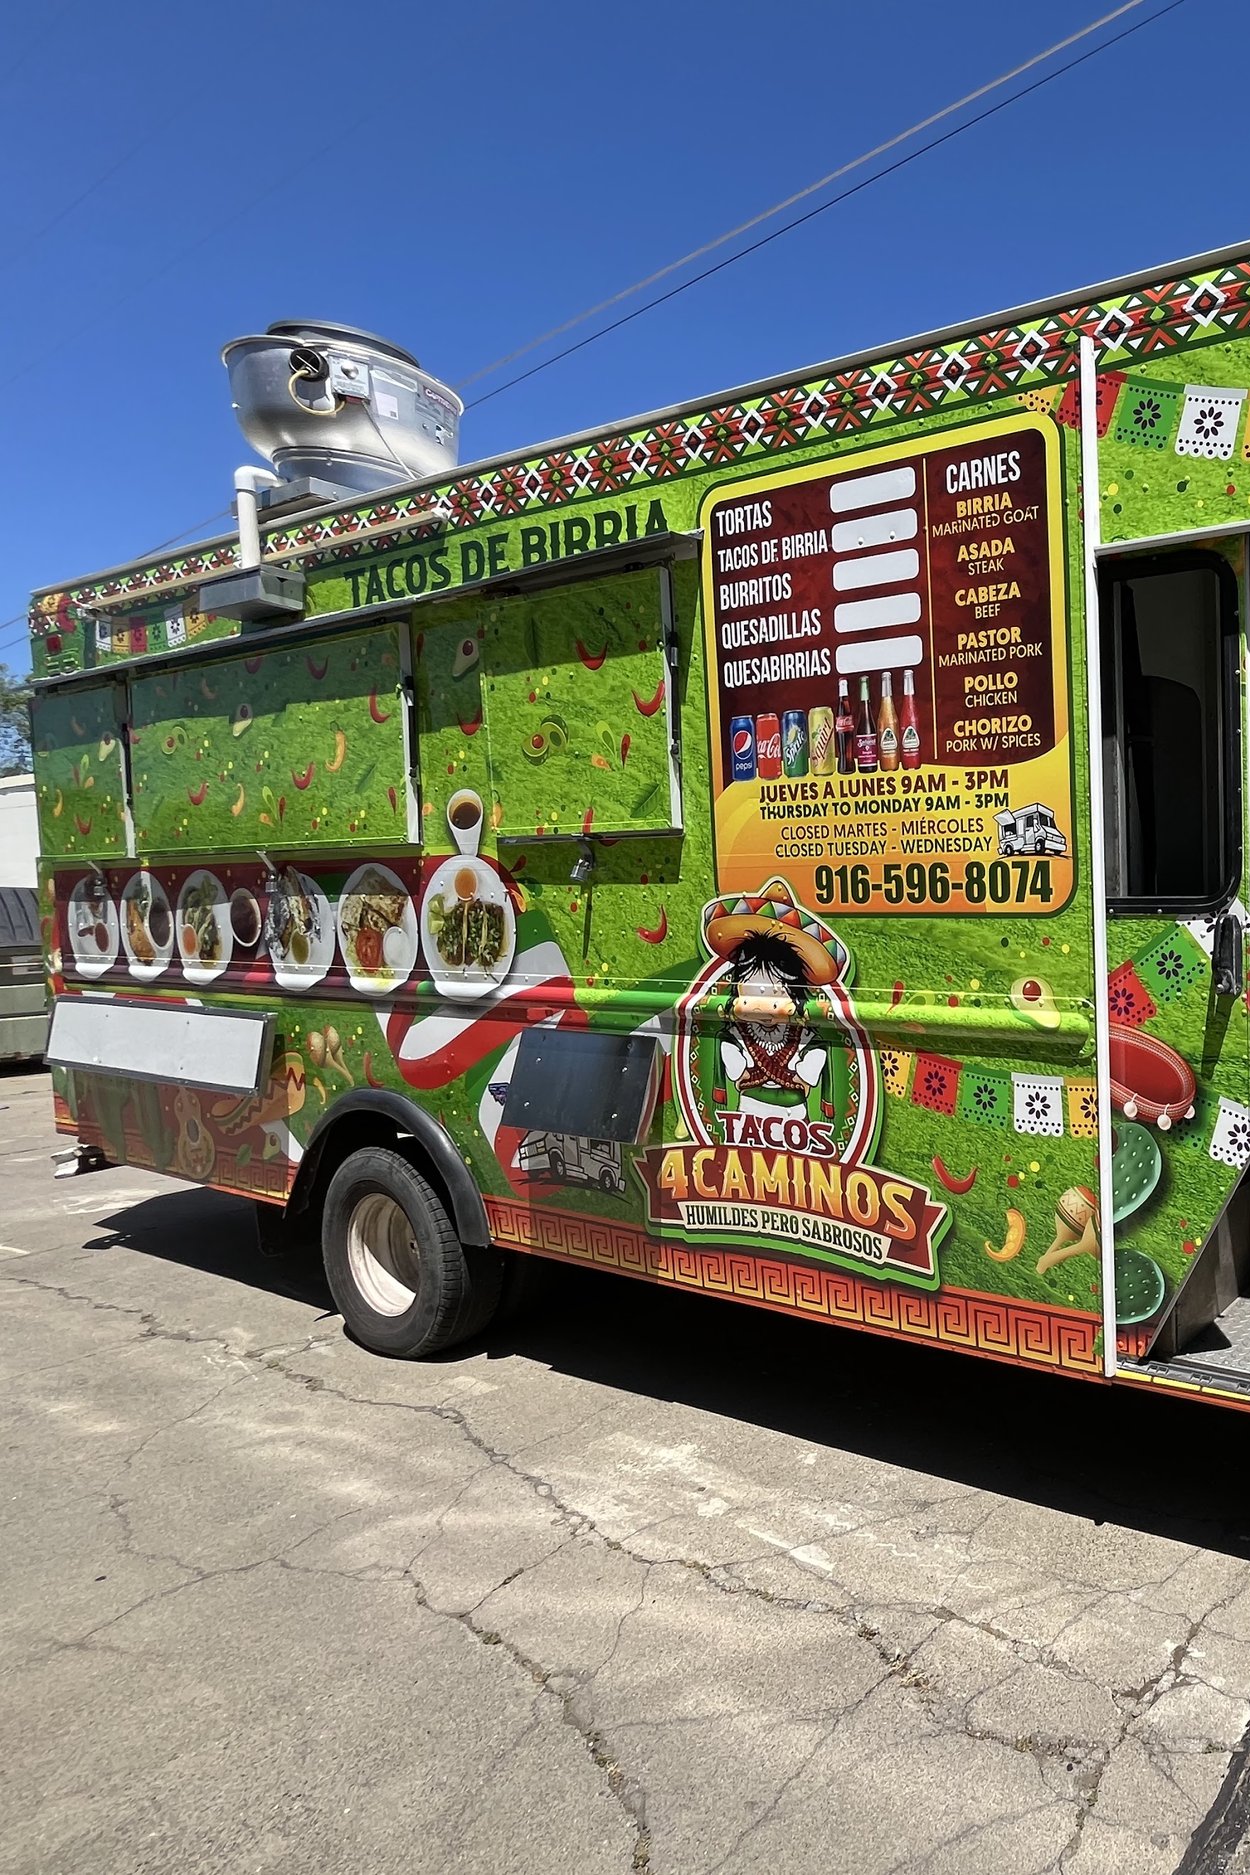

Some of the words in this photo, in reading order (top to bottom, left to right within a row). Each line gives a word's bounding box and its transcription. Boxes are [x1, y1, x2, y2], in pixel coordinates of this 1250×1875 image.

[946, 450, 1020, 494] CARNES
[956, 492, 1013, 518] BIRRIA
[716, 500, 772, 537] TORTAS
[932, 513, 1000, 538] MARINATED
[1003, 505, 1039, 525] GOAT
[345, 547, 450, 608] TACOS
[461, 532, 510, 583] DE
[520, 500, 669, 567] BIRRIA
[717, 543, 758, 573] TACOS
[761, 539, 779, 565] DE
[781, 529, 829, 560] BIRRIA
[957, 537, 1015, 562] ASADA
[968, 558, 1004, 576] STEAK
[720, 572, 792, 611] BURRITOS
[955, 582, 1021, 606] CABEZA
[975, 603, 1000, 619] BEEF
[721, 608, 821, 650] QUESADILLAS
[957, 626, 1022, 650] PASTOR
[723, 648, 832, 688] QUESABIRRIAS
[938, 648, 1006, 668] MARINATED
[1009, 642, 1043, 659] PORK
[964, 671, 1019, 693] POLLO
[965, 690, 1018, 708] CHICKEN
[953, 714, 1032, 738] CHORIZO
[946, 739, 977, 753] PORK
[980, 736, 998, 751] W/
[1001, 733, 1041, 749] SPICES
[735, 762, 753, 772] pepsi
[759, 781, 818, 804] JUEVES
[823, 781, 834, 799] A
[839, 775, 896, 798] LUNES
[900, 773, 946, 794] 9AM
[964, 769, 1009, 790] 3PM
[759, 801, 830, 820] THURSDAY
[831, 800, 850, 816] TO
[854, 797, 920, 815] MONDAY
[925, 795, 960, 811] 9AM
[974, 792, 1009, 809] 3PM
[781, 824, 830, 840] CLOSED
[833, 821, 888, 839] MARTES
[901, 817, 984, 836] MIÉRCOLES
[775, 842, 823, 858] CLOSED
[827, 840, 886, 857] TUESDAY
[900, 836, 992, 854] WEDNESDAY
[815, 860, 1053, 904] 916-596-8074
[716, 1112, 835, 1156] TACOS
[685, 1205, 758, 1228] HUMILDES
[761, 1211, 799, 1234] PERO
[802, 1218, 883, 1260] SABROSOS
